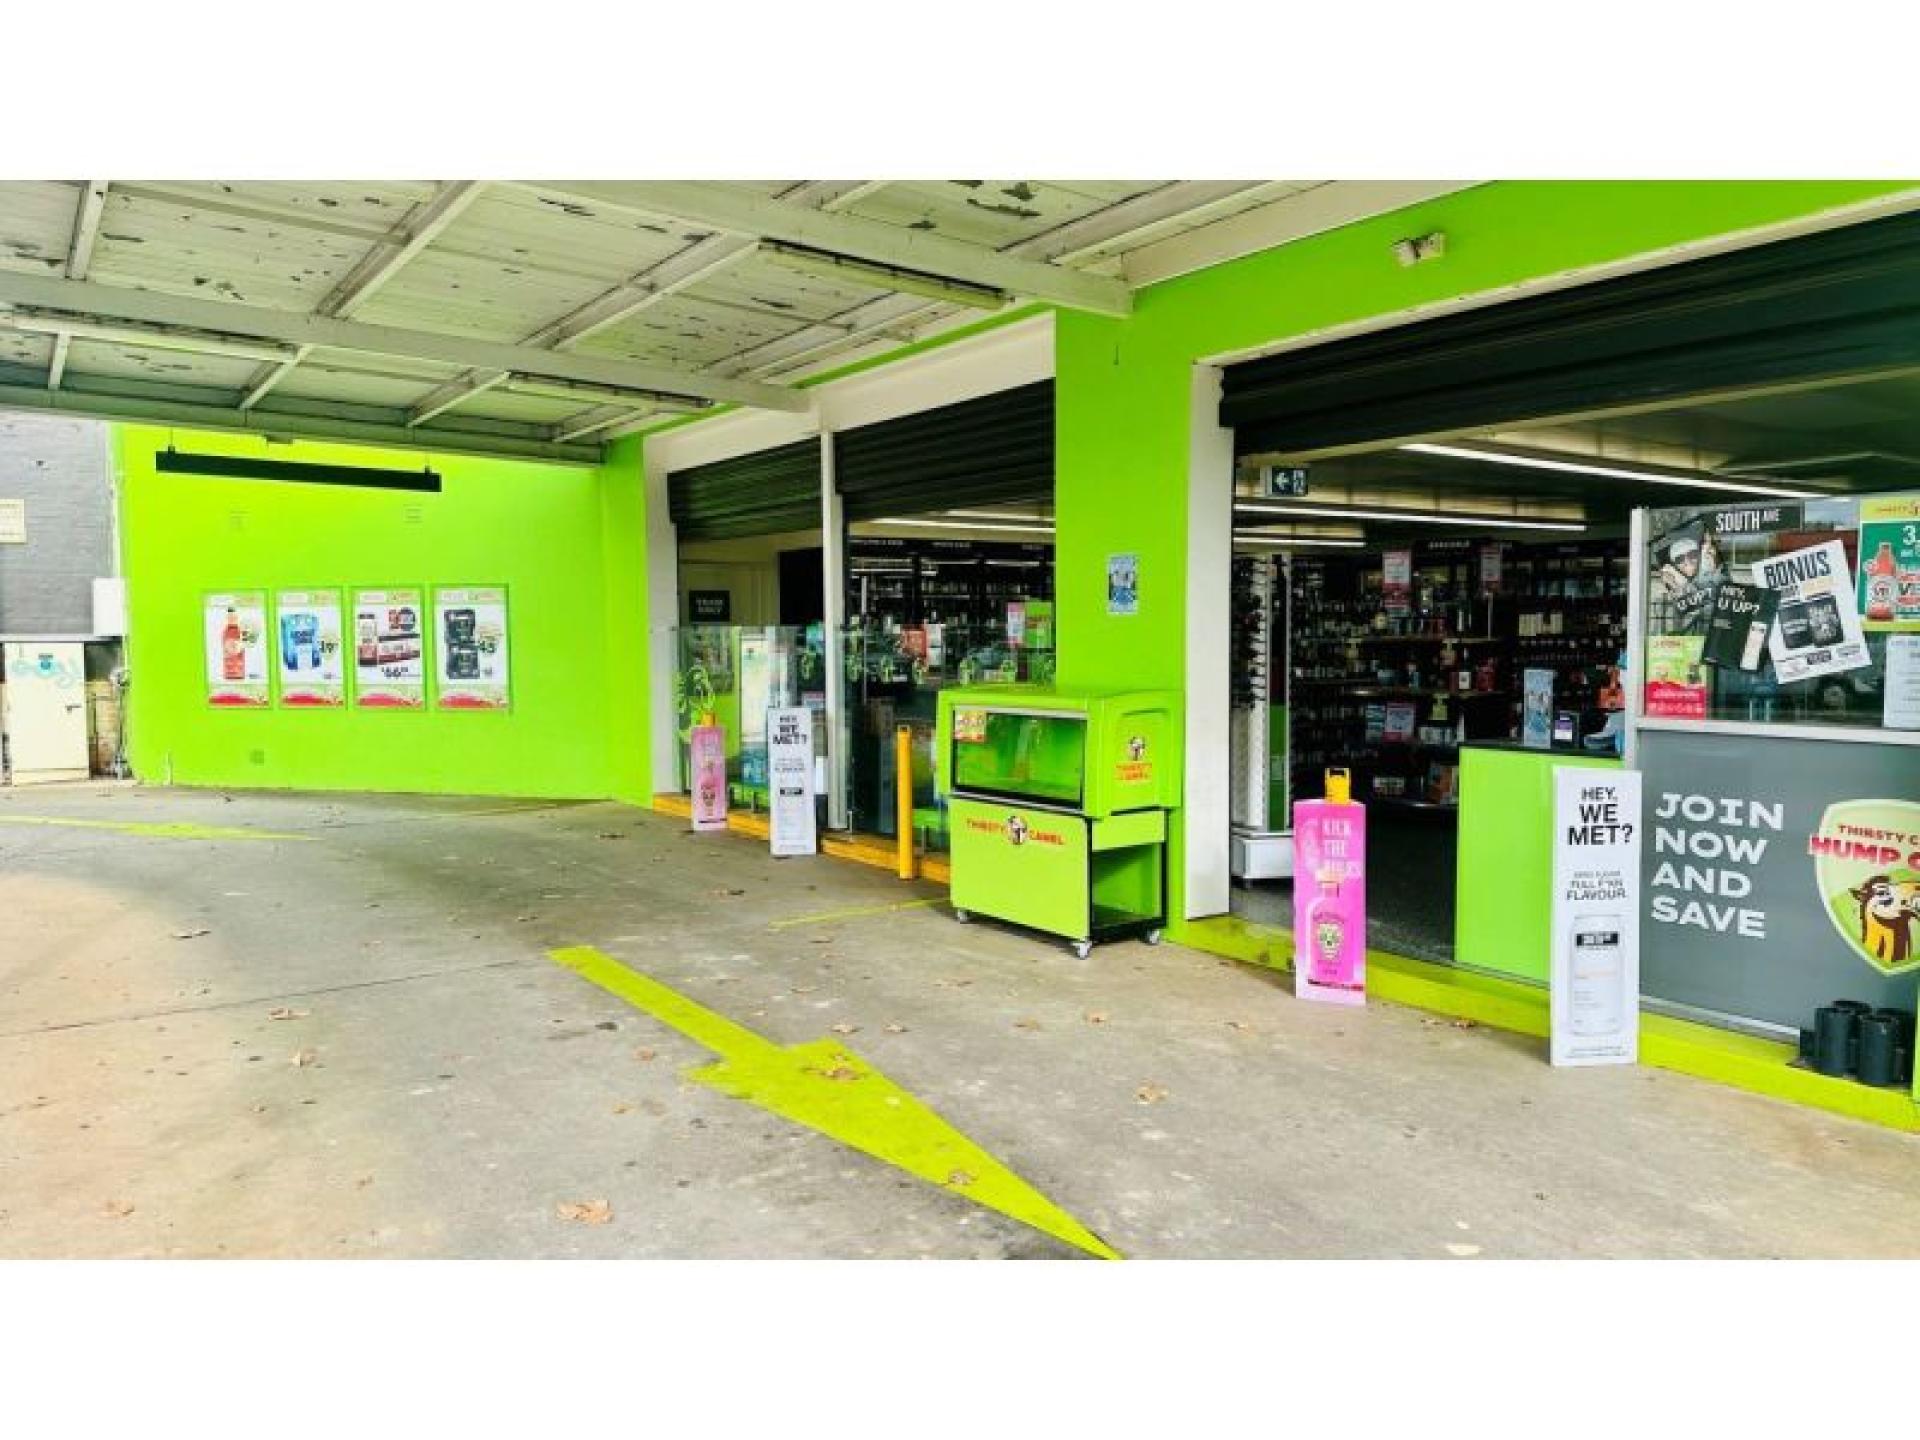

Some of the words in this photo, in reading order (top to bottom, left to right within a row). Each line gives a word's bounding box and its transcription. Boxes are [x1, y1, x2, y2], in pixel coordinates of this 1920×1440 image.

[1715, 510, 1760, 533] SOUTH
[1763, 550, 1831, 588] BONUS
[1579, 803, 1619, 823] WE
[1655, 792, 1784, 831] JOIN
[1567, 823, 1633, 846] MET?
[1655, 827, 1769, 865] NOW
[1808, 834, 1902, 866] HUMP
[1838, 824, 1905, 843] THIRSTY
[1651, 861, 1753, 898] AND
[1650, 895, 1766, 939] SAVE
